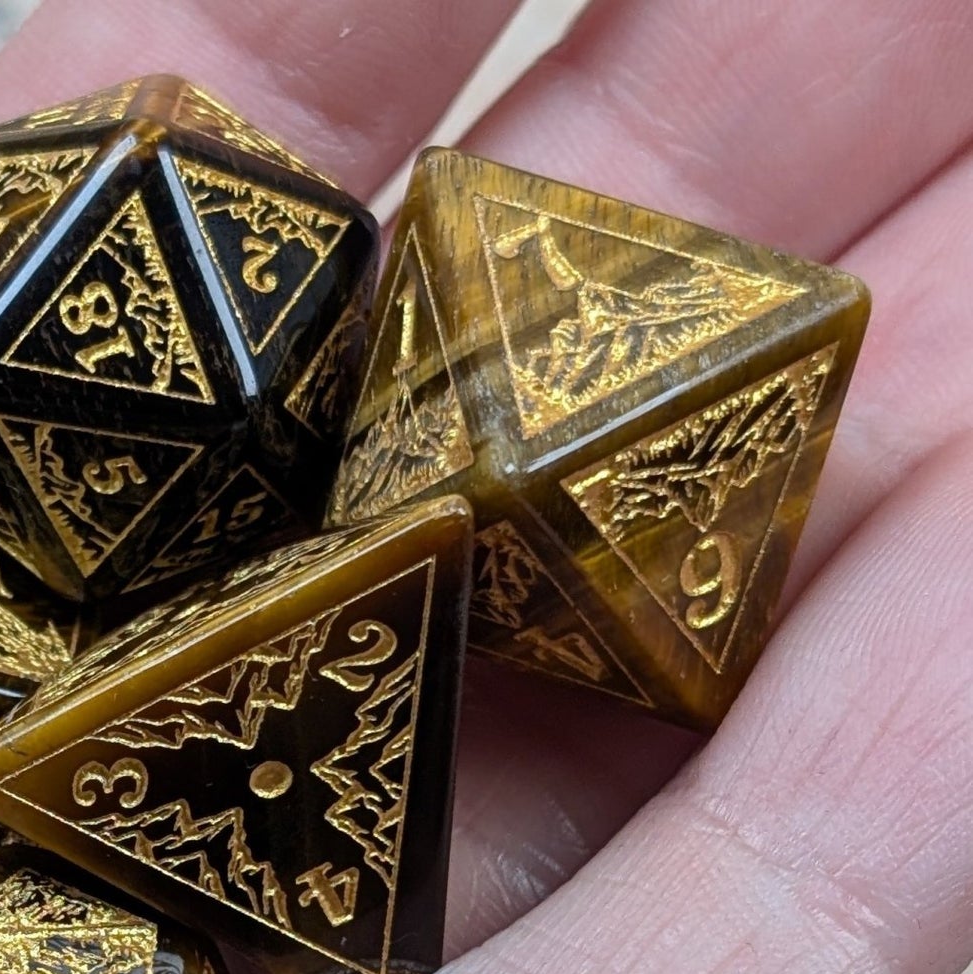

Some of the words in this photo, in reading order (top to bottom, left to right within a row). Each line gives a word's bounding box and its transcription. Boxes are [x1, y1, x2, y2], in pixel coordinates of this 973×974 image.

[241, 236, 279, 294] 2
[492, 214, 584, 292] 7
[59, 281, 135, 374] 18
[393, 275, 419, 377] 1
[82, 455, 147, 495] 5
[192, 491, 267, 543] 15
[318, 619, 398, 692] 2
[513, 625, 605, 682] 4
[72, 758, 149, 808] 3
[295, 862, 360, 927] 4
